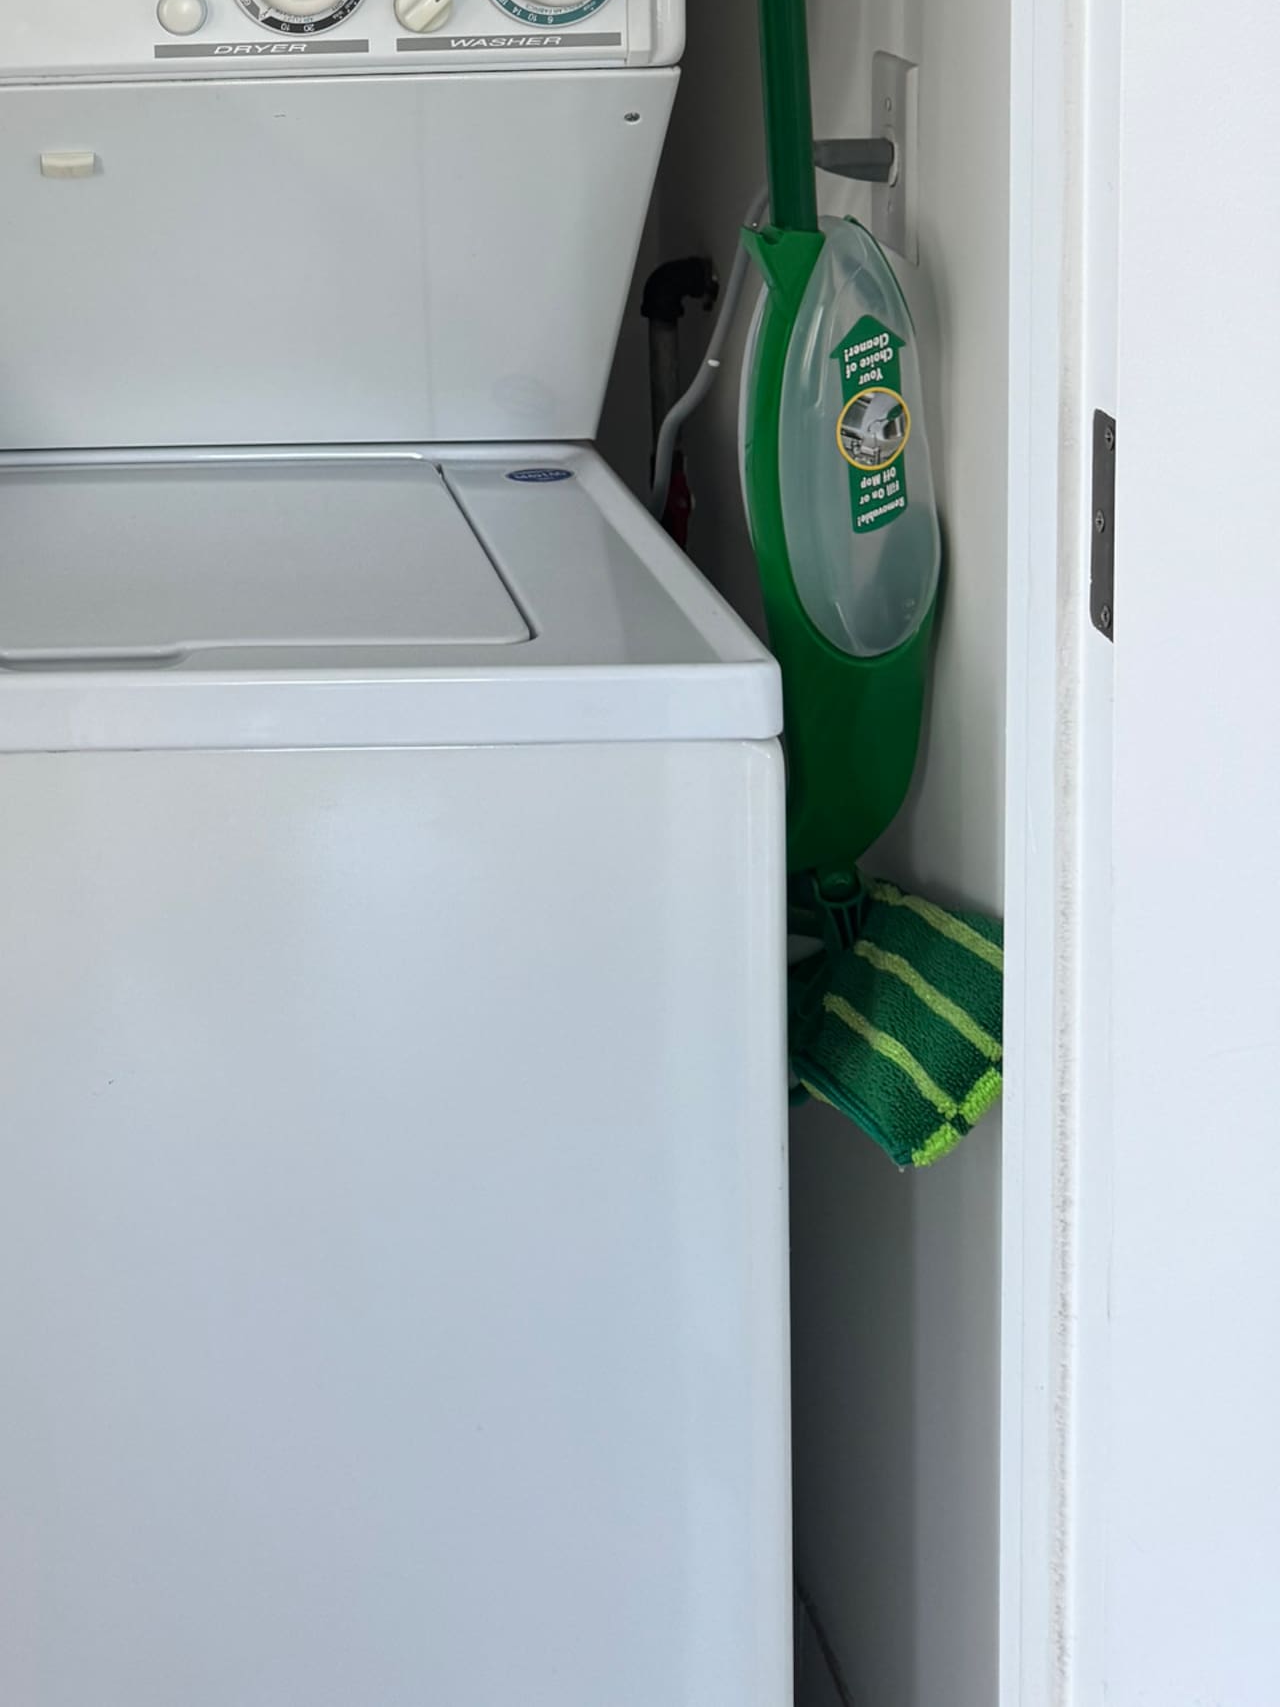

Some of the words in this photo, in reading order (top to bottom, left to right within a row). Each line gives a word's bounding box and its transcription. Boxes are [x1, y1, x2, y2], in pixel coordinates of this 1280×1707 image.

[214, 43, 307, 55] DRYER
[450, 36, 562, 48] WASHER
[844, 333, 889, 362] Cleaner!
[859, 347, 893, 368] Choice
[846, 362, 857, 379] of
[858, 367, 884, 385] Your
[860, 473, 881, 488] Mop
[883, 466, 896, 483] Off
[871, 488, 885, 499] On
[886, 480, 900, 496] Fill
[859, 494, 870, 505] or
[857, 496, 905, 527] Removable!
